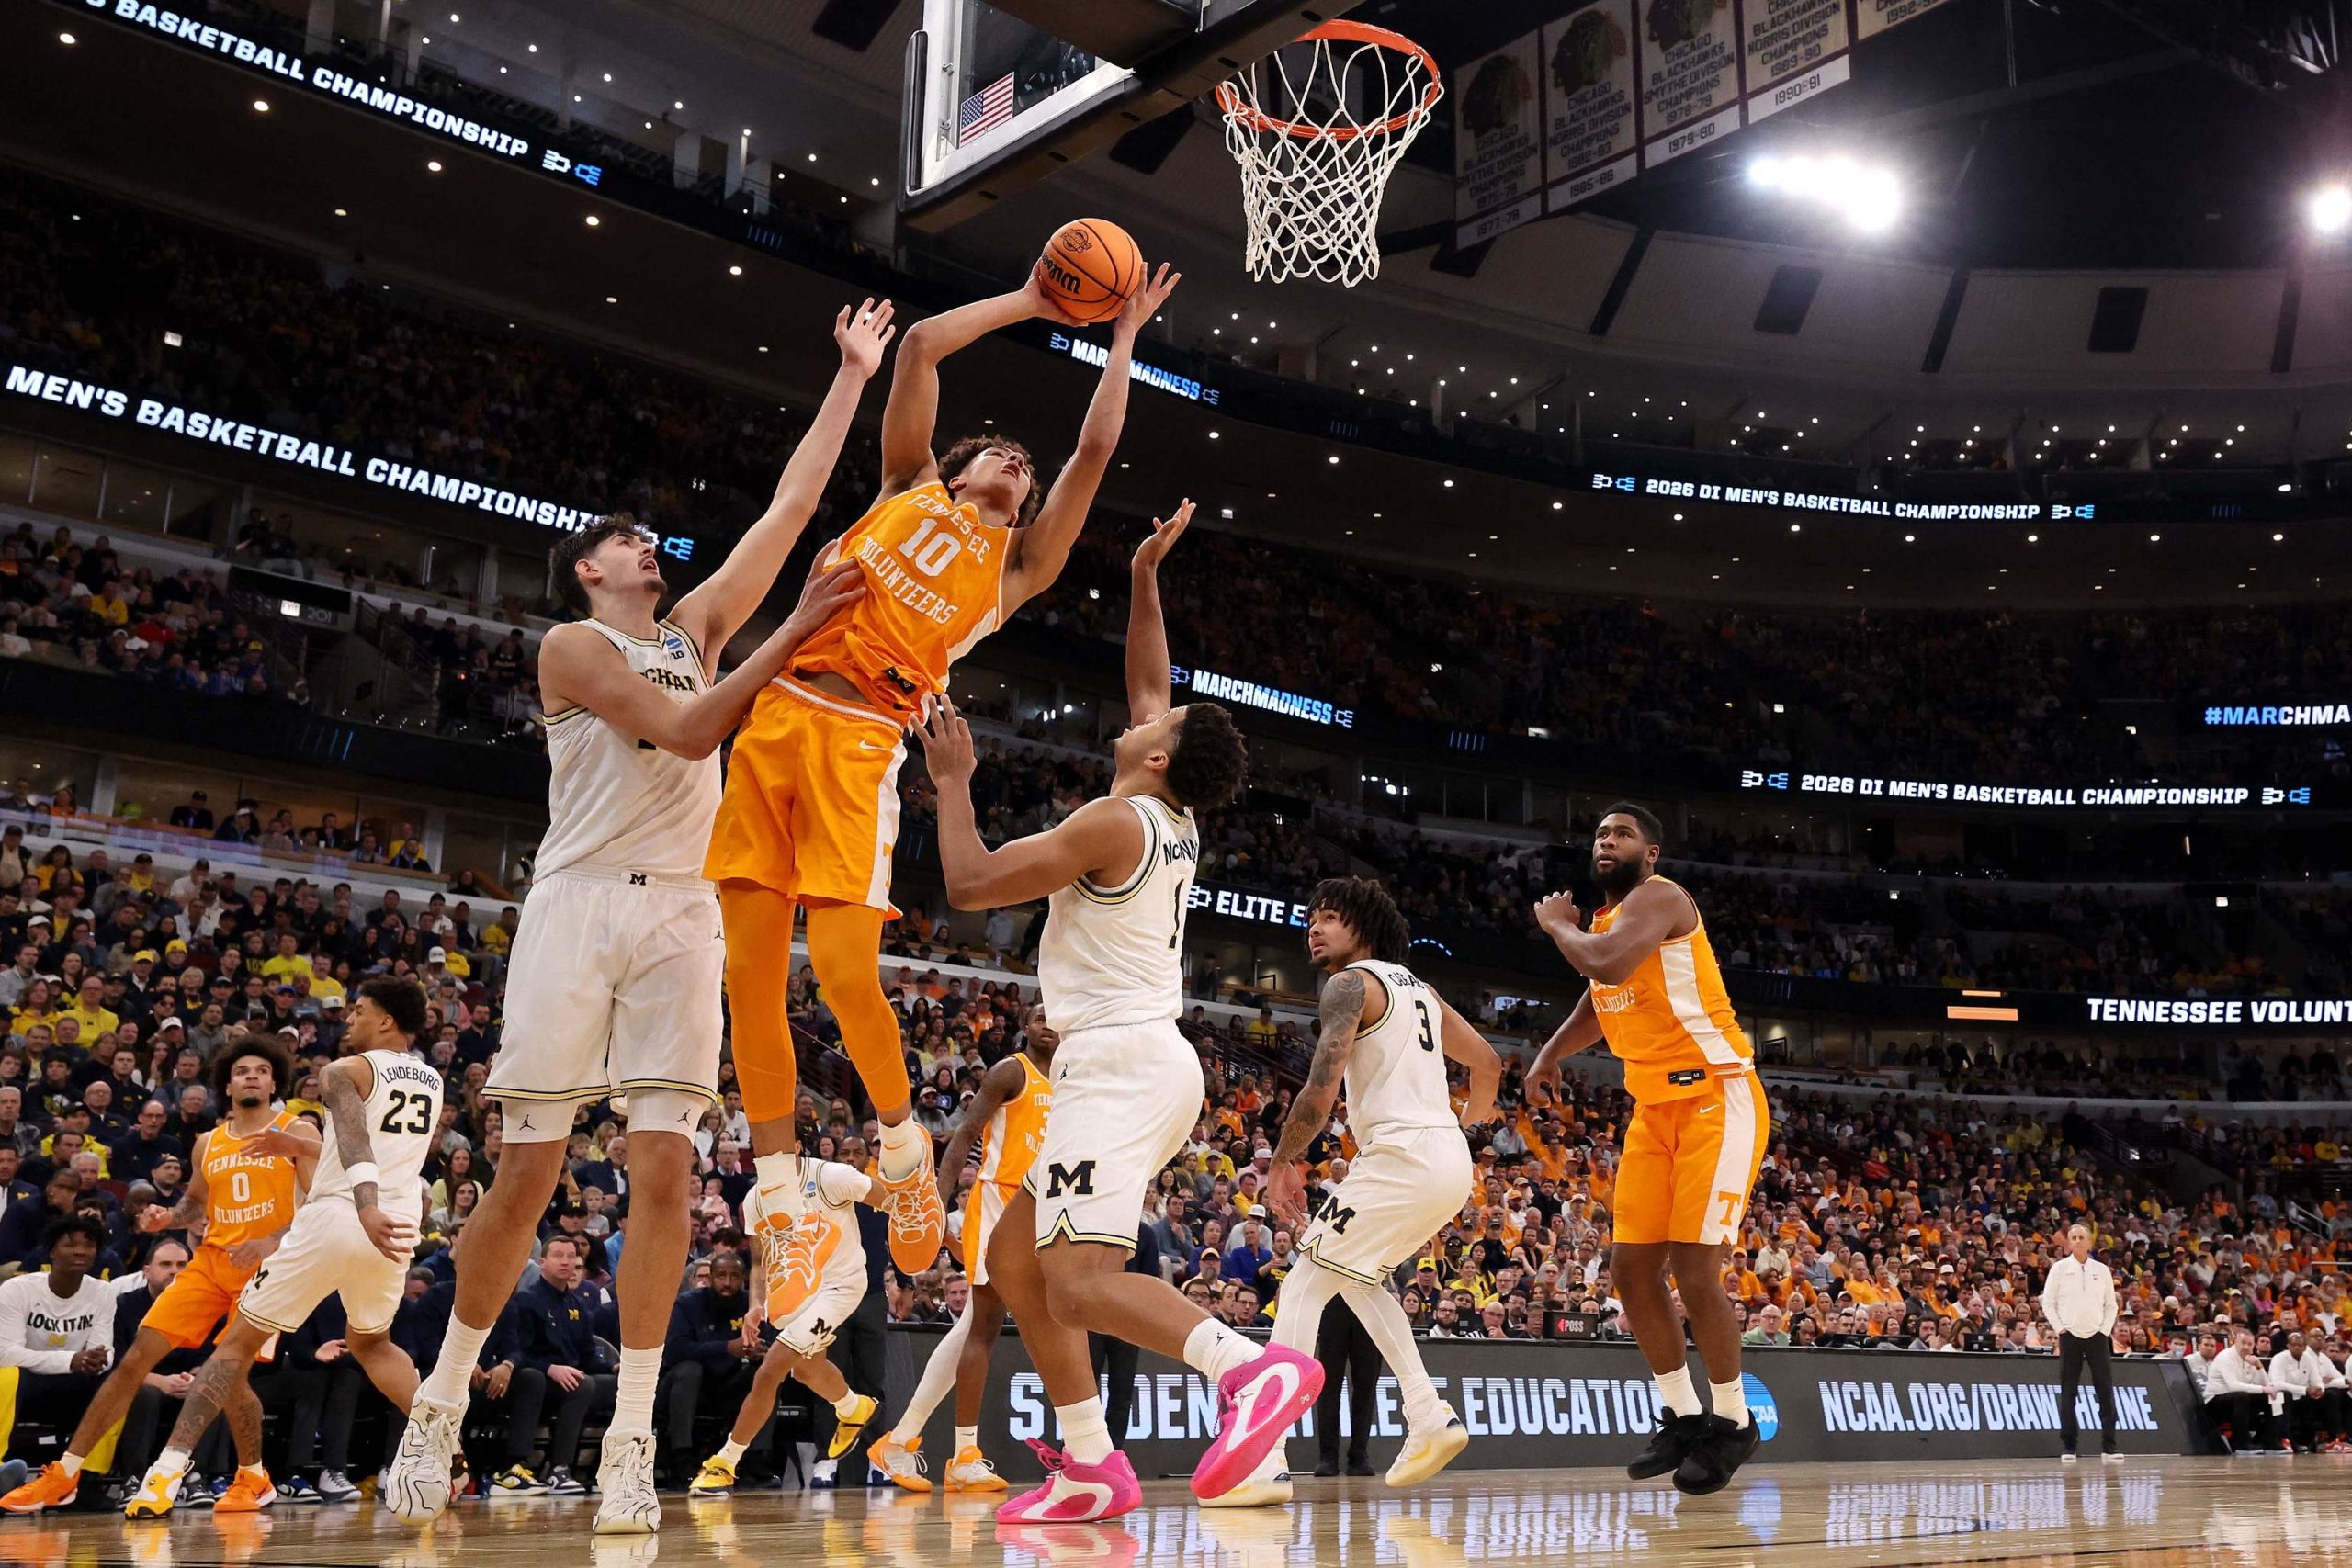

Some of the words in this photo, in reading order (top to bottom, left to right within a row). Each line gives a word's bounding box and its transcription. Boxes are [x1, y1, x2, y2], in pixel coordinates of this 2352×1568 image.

[1665, 33, 1711, 64] CHICAGO
[1747, 27, 1790, 55] NORRIS
[1792, 2, 1840, 35] DIVISION
[1761, 24, 1828, 65] CHAMPIONS
[114, 0, 306, 81] BASKETBALL
[312, 66, 529, 157] CHAMPIONSHIP
[1644, 75, 1689, 105] SMYTHE
[1690, 51, 1735, 84] DIVISION
[1652, 40, 1725, 86] BLACKHAWKS
[1657, 75, 1720, 112] CHAMPIONS
[1071, 338, 1201, 400] MARMADNESS
[6, 365, 128, 417] MEN'S
[136, 399, 356, 476] BASKETBALL
[366, 457, 595, 538] CHAMPIONSHI
[1645, 479, 1695, 498] 2026
[1699, 484, 1721, 500] DI
[1724, 487, 1780, 506] MEN'S
[1783, 491, 1891, 516] BASKETBALL
[1894, 502, 2041, 520] CHAMPIONSHIP
[897, 518, 962, 577] 10
[1192, 669, 1333, 725] MARCHMADNESS
[1801, 774, 1855, 794] 2026
[1860, 778, 1884, 796] DI
[1888, 780, 1949, 800] MEN'S
[1952, 784, 2076, 806] BASKETBALL
[2082, 787, 2249, 806] CHAMPIONSHIP
[629, 873, 647, 886] M
[1216, 890, 1286, 924] ELITE
[1415, 1000, 1434, 1052] 3
[2086, 998, 2243, 1023] TENNESSEE
[380, 1060, 441, 1092] LENDEBORG
[379, 1089, 434, 1135] 23
[232, 1171, 251, 1203] 0
[1046, 1160, 1096, 1199] M
[1318, 1195, 1357, 1235] M
[1718, 1191, 1742, 1225] T
[27, 1312, 61, 1332] LOCK
[63, 1318, 77, 1332] IT
[1564, 1318, 1585, 1333] POSS
[1818, 1381, 2159, 1432] NCAA.ORG/DRAWHEINE
